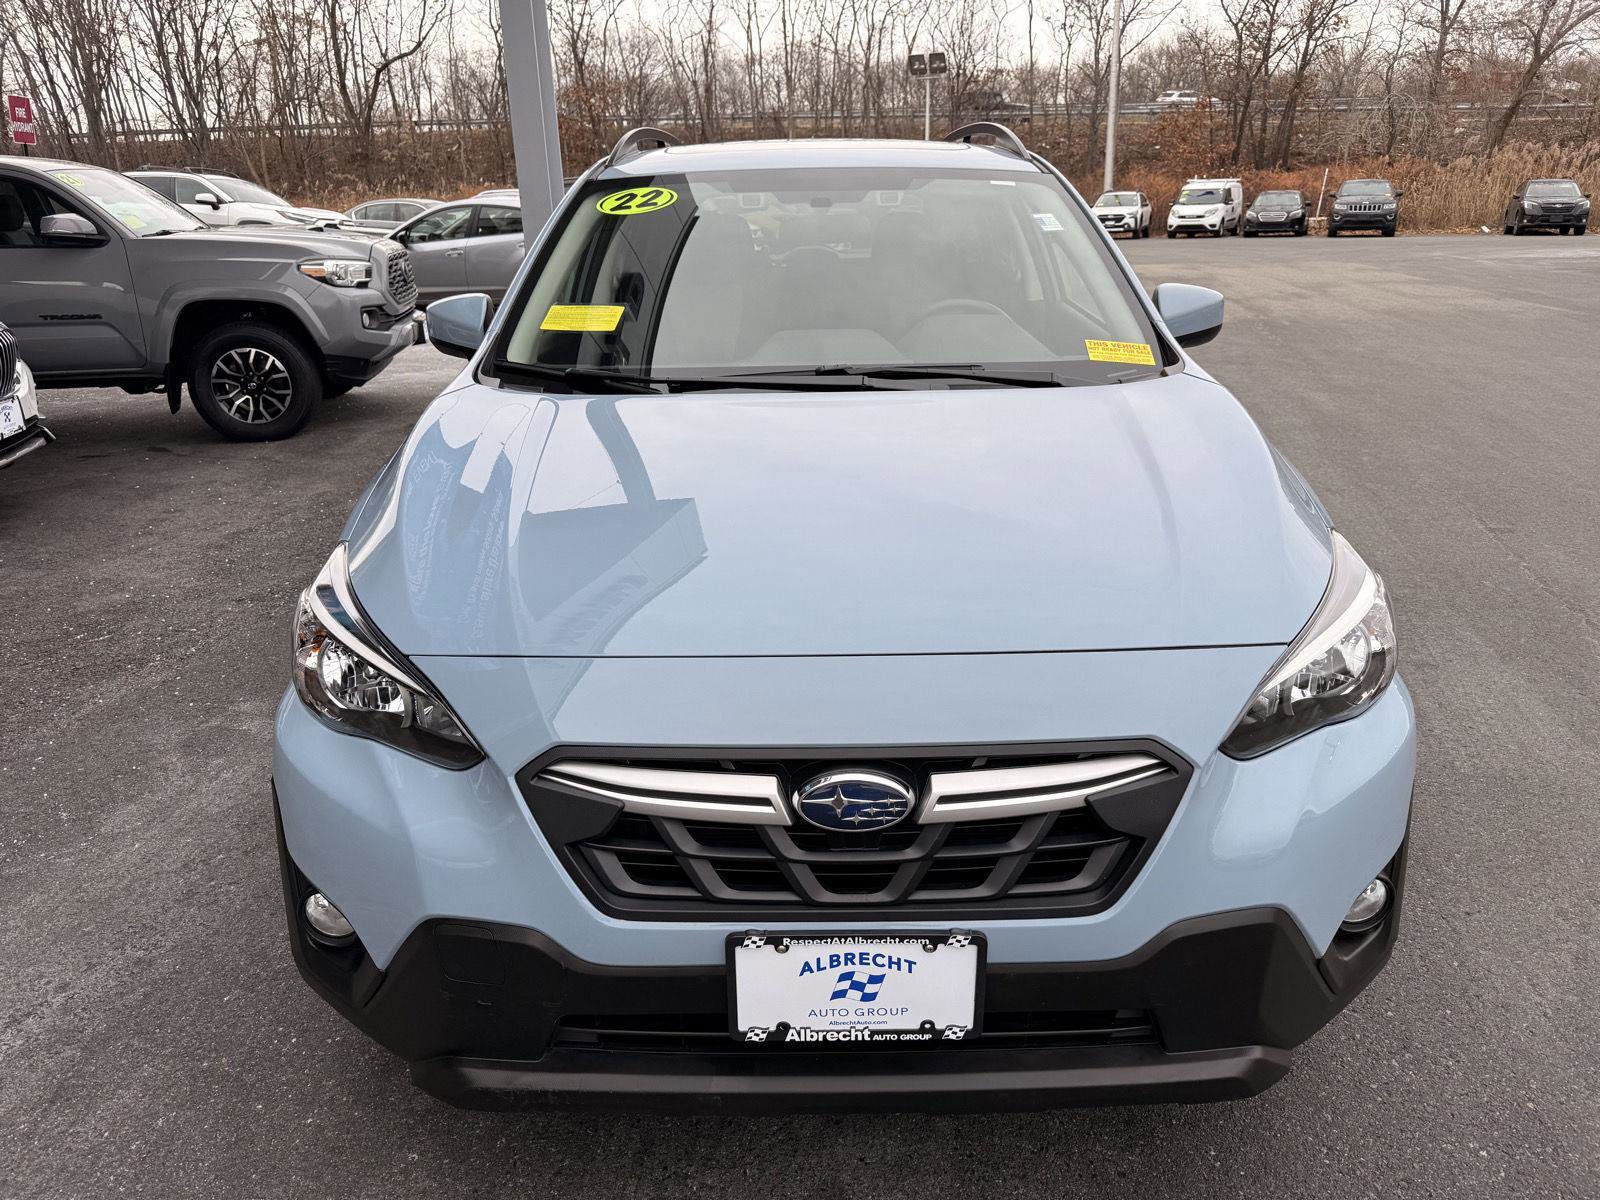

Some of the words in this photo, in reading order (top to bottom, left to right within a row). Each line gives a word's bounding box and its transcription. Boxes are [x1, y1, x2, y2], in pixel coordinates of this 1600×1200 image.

[609, 189, 664, 212] 22
[39, 313, 103, 321] TACOMA
[1110, 342, 1149, 351] VEHICLE
[783, 937, 930, 947] RespectAtAlbrecht.com
[798, 952, 917, 977] ALBRECHT
[808, 1008, 849, 1018] AUTO
[854, 1007, 909, 1017] GROUP
[785, 1026, 871, 1042] Albrecht
